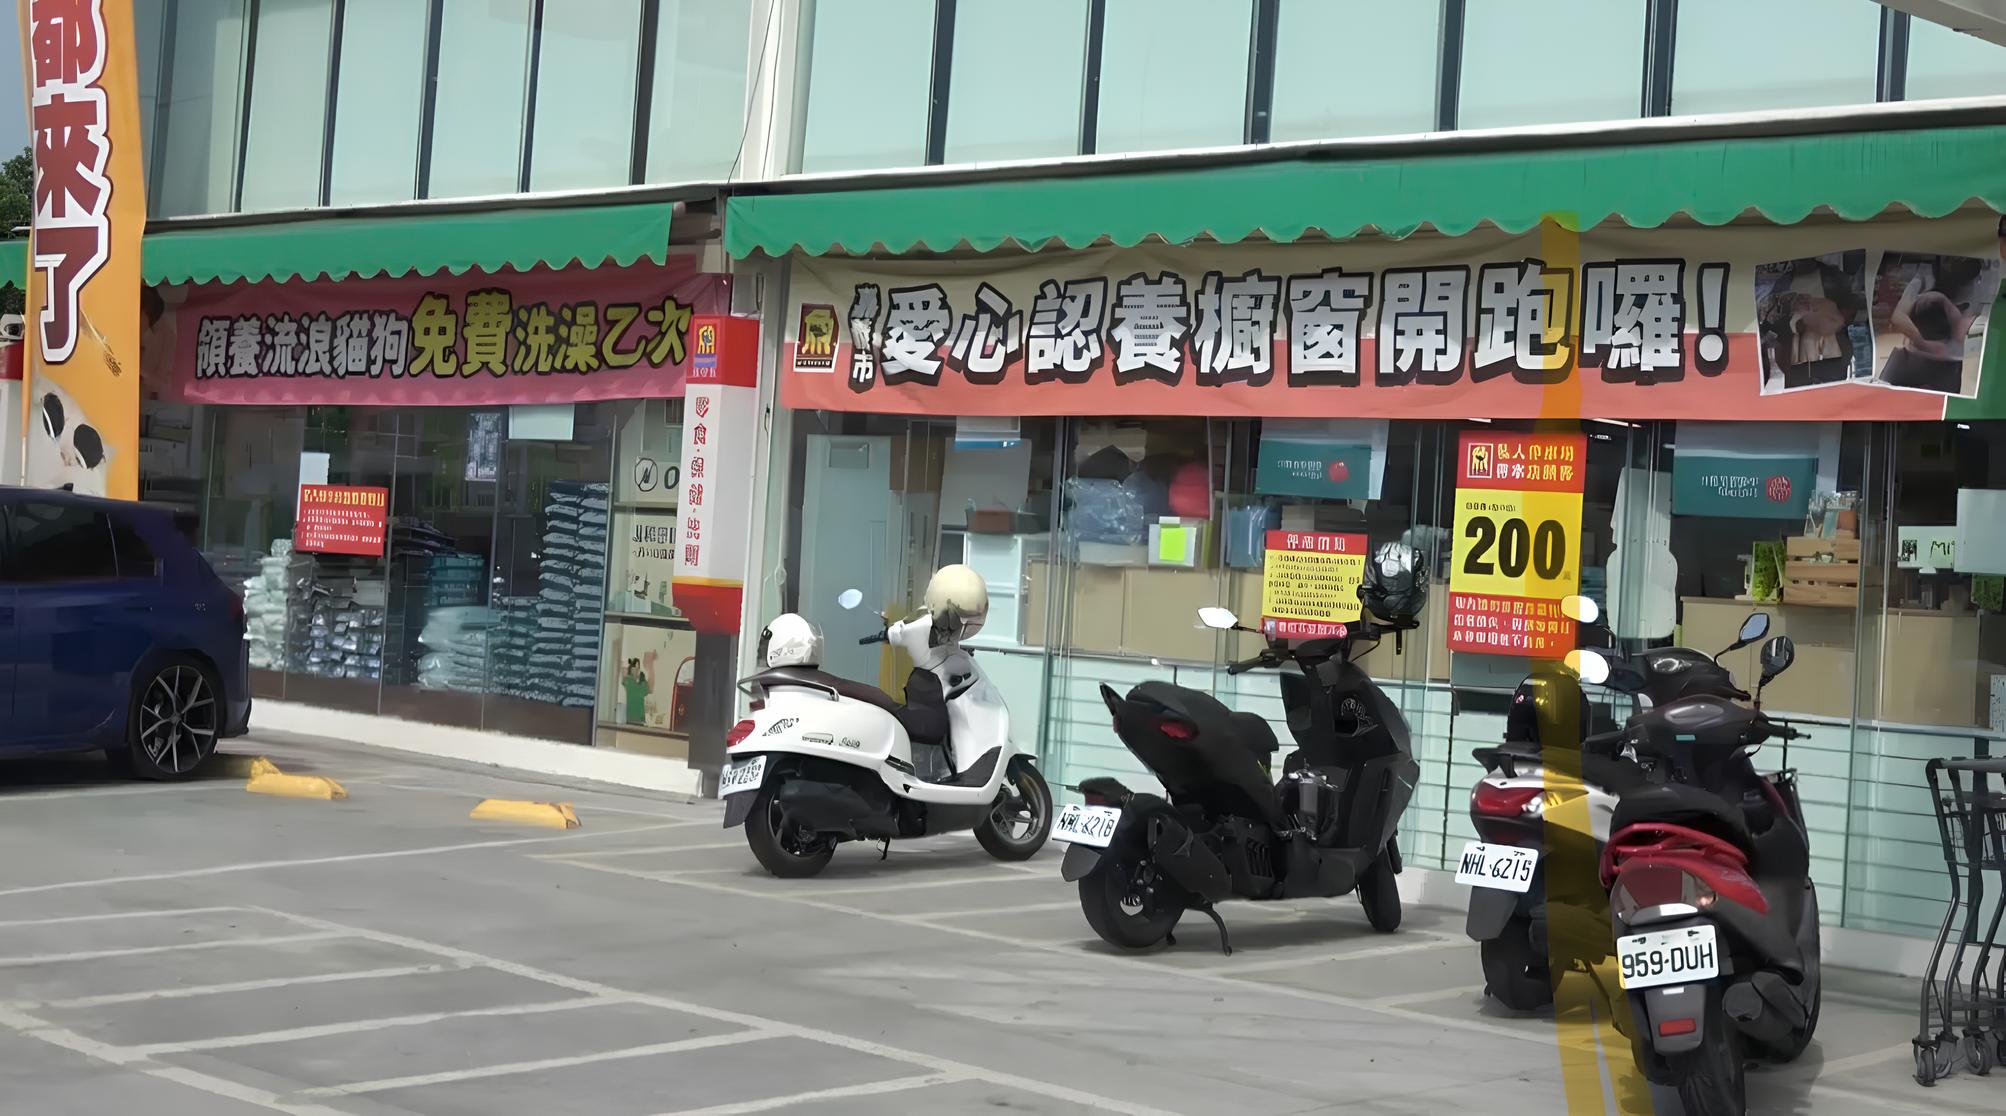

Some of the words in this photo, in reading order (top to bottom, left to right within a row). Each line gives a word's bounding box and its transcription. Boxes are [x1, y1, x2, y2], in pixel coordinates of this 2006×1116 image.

[1464, 516, 1566, 580] 200
[1460, 853, 1531, 881] NHL-6215
[1622, 942, 1714, 979] 959-DUH
